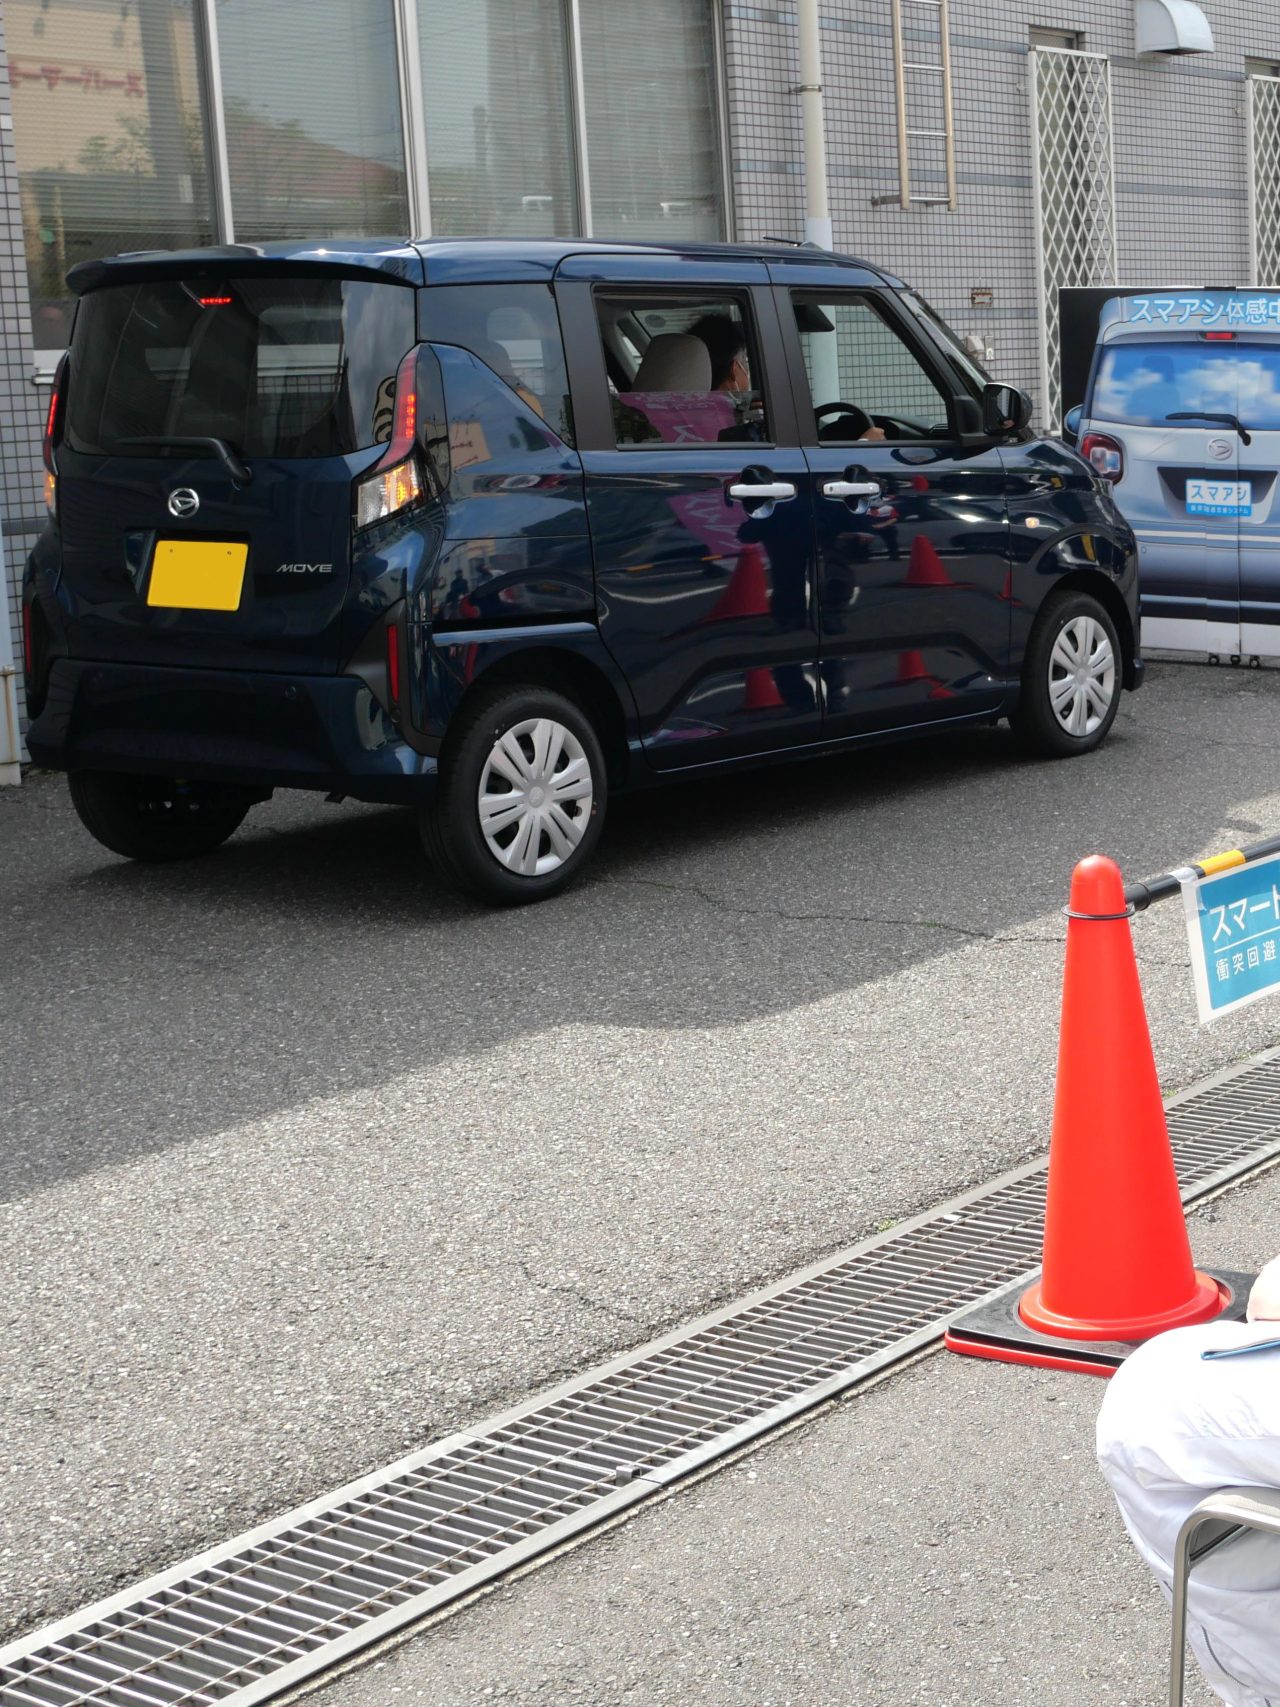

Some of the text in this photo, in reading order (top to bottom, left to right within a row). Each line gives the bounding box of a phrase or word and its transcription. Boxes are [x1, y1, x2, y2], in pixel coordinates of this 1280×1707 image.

[1191, 484, 1247, 501] スマアシ
[276, 564, 333, 573] MOVE
